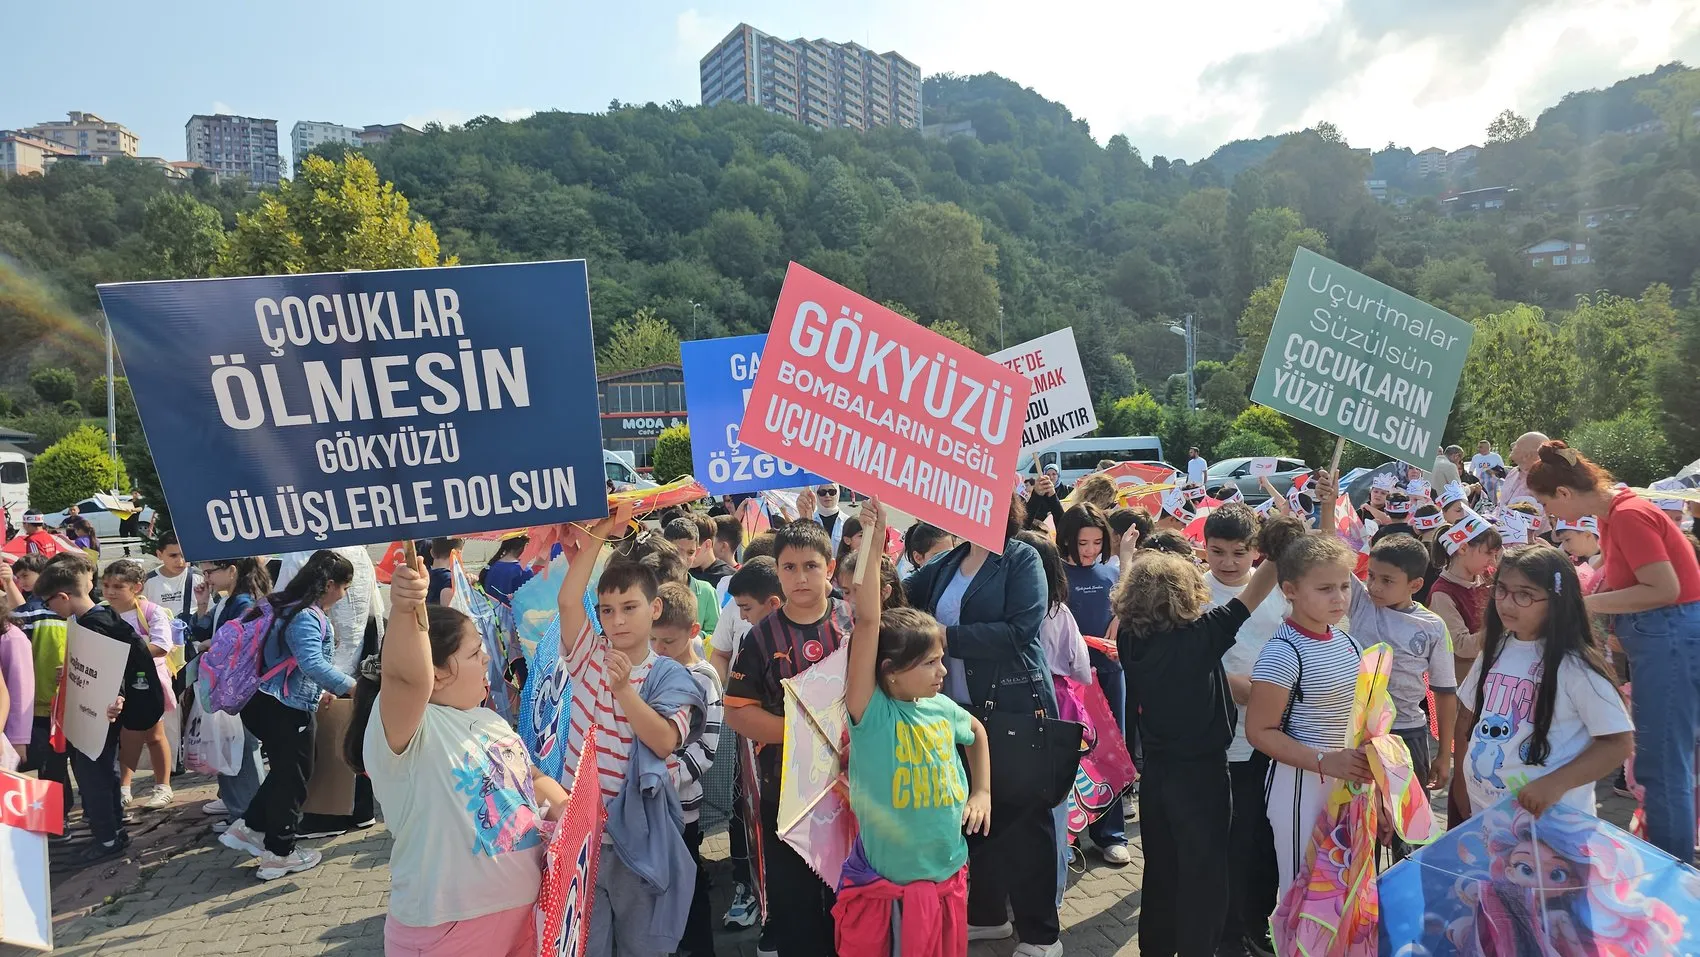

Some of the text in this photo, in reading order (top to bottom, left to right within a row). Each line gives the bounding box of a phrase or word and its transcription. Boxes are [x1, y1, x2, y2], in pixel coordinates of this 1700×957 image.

[254, 288, 465, 357] ÇOCUKLAR
[1307, 266, 1459, 351] Uçurtmalar
[1309, 308, 1433, 379] Süzülsün
[210, 339, 531, 430] ÖLMESİN
[789, 301, 1013, 445] GÖKYÜZÜ
[1272, 368, 1431, 458] YÜZÜ GÜLSÜN
[1283, 333, 1434, 419] ÇOCUKLARIN
[314, 422, 460, 474] GÖKYÜZÜ
[623, 418, 665, 429] MODA
[777, 360, 934, 449] BOMBALARIN
[937, 433, 999, 480] DEĞİL
[1020, 407, 1090, 448] ALMAKTIR
[708, 451, 812, 483] ÖZG
[764, 394, 994, 527] UÇURTMALARINDIR
[206, 466, 578, 541] GÜLÜŞLERLE DOLSUN
